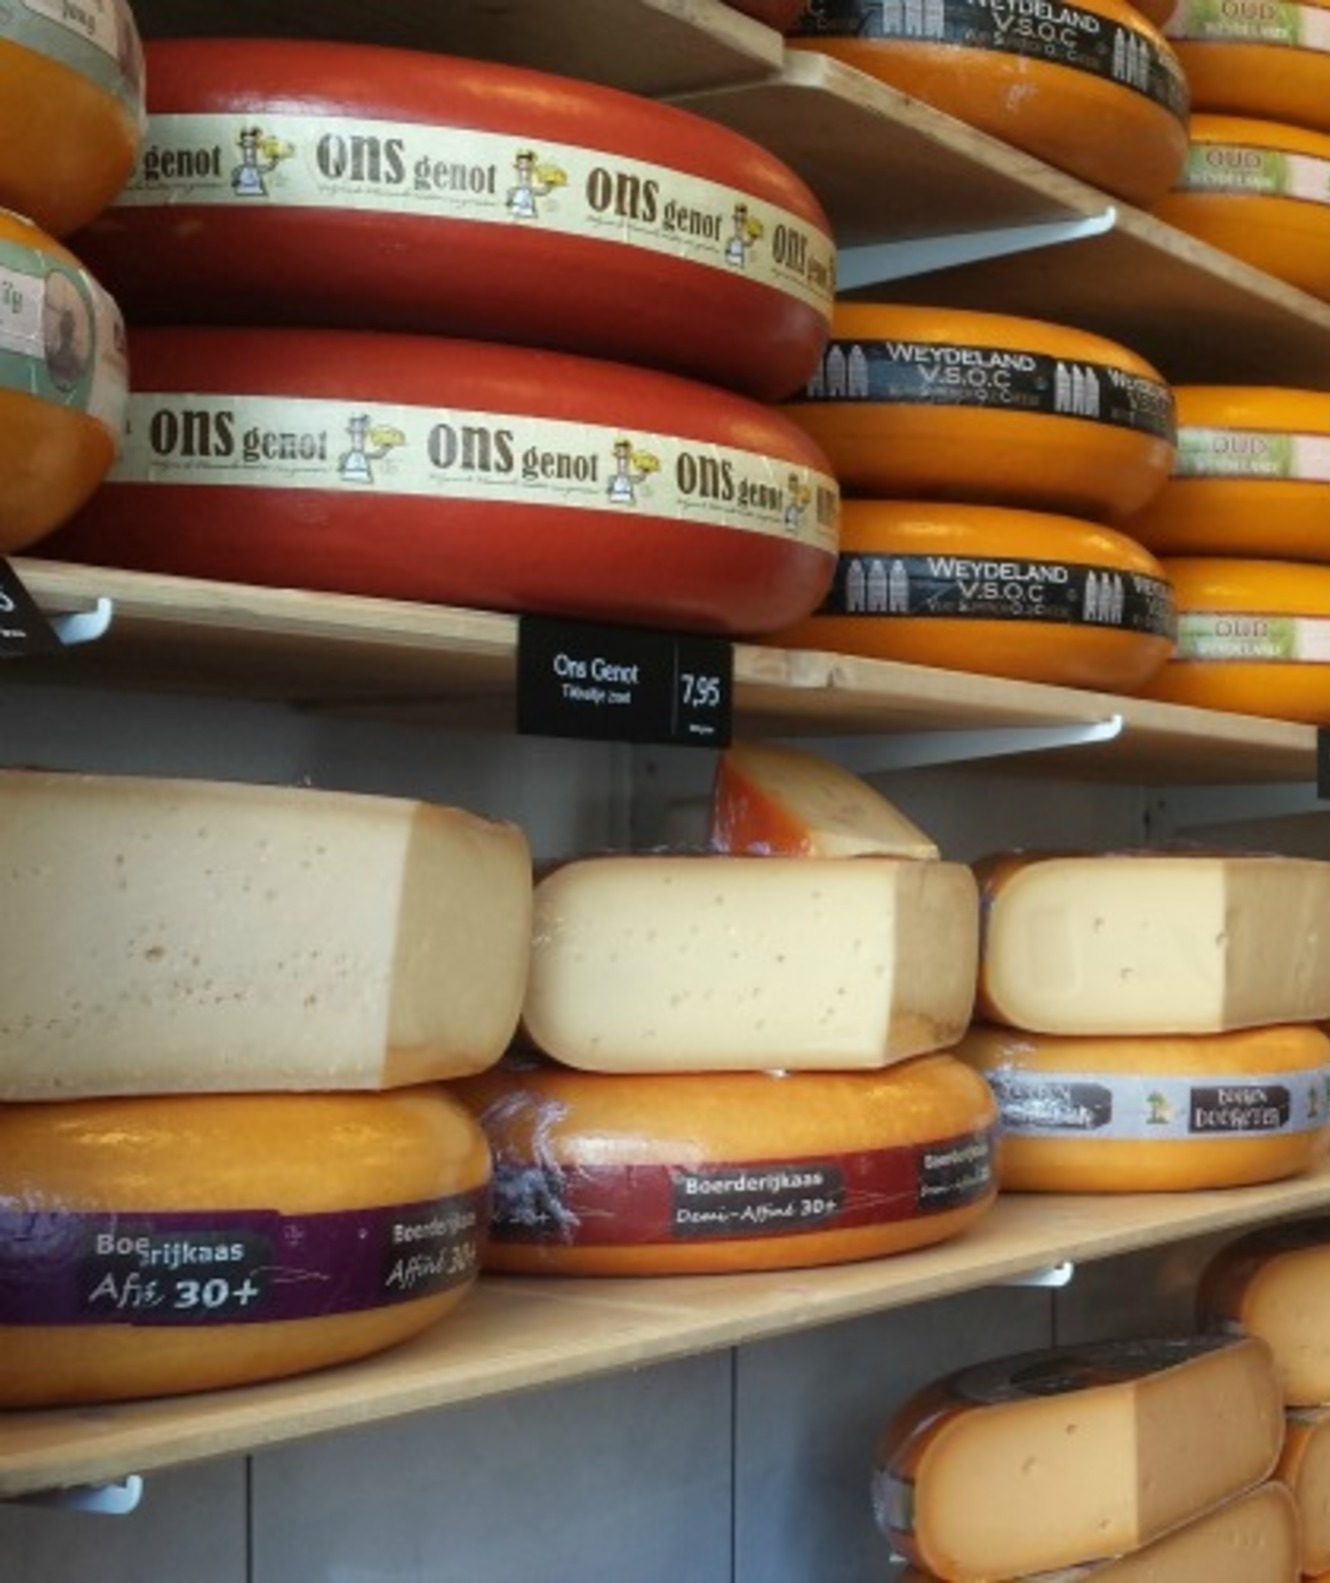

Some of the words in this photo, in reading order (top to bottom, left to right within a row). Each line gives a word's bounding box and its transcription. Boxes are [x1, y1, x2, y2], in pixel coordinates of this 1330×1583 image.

[143, 144, 223, 181] genot
[315, 132, 406, 185] ons
[413, 155, 498, 195] genot
[586, 166, 660, 223] ons
[661, 200, 723, 242] genot
[885, 341, 1036, 372] WEYDELAND
[150, 407, 236, 457] ons
[242, 425, 328, 462] genot
[426, 422, 515, 474] ons
[521, 446, 600, 483] genot
[675, 451, 736, 501] ons
[926, 556, 1069, 584] WEYDELAND
[553, 653, 587, 679] Ons
[590, 657, 640, 684] Genot
[680, 673, 721, 708] 7,95
[685, 1171, 824, 1195] Boerderijkaas
[173, 1277, 260, 1309] 30+
